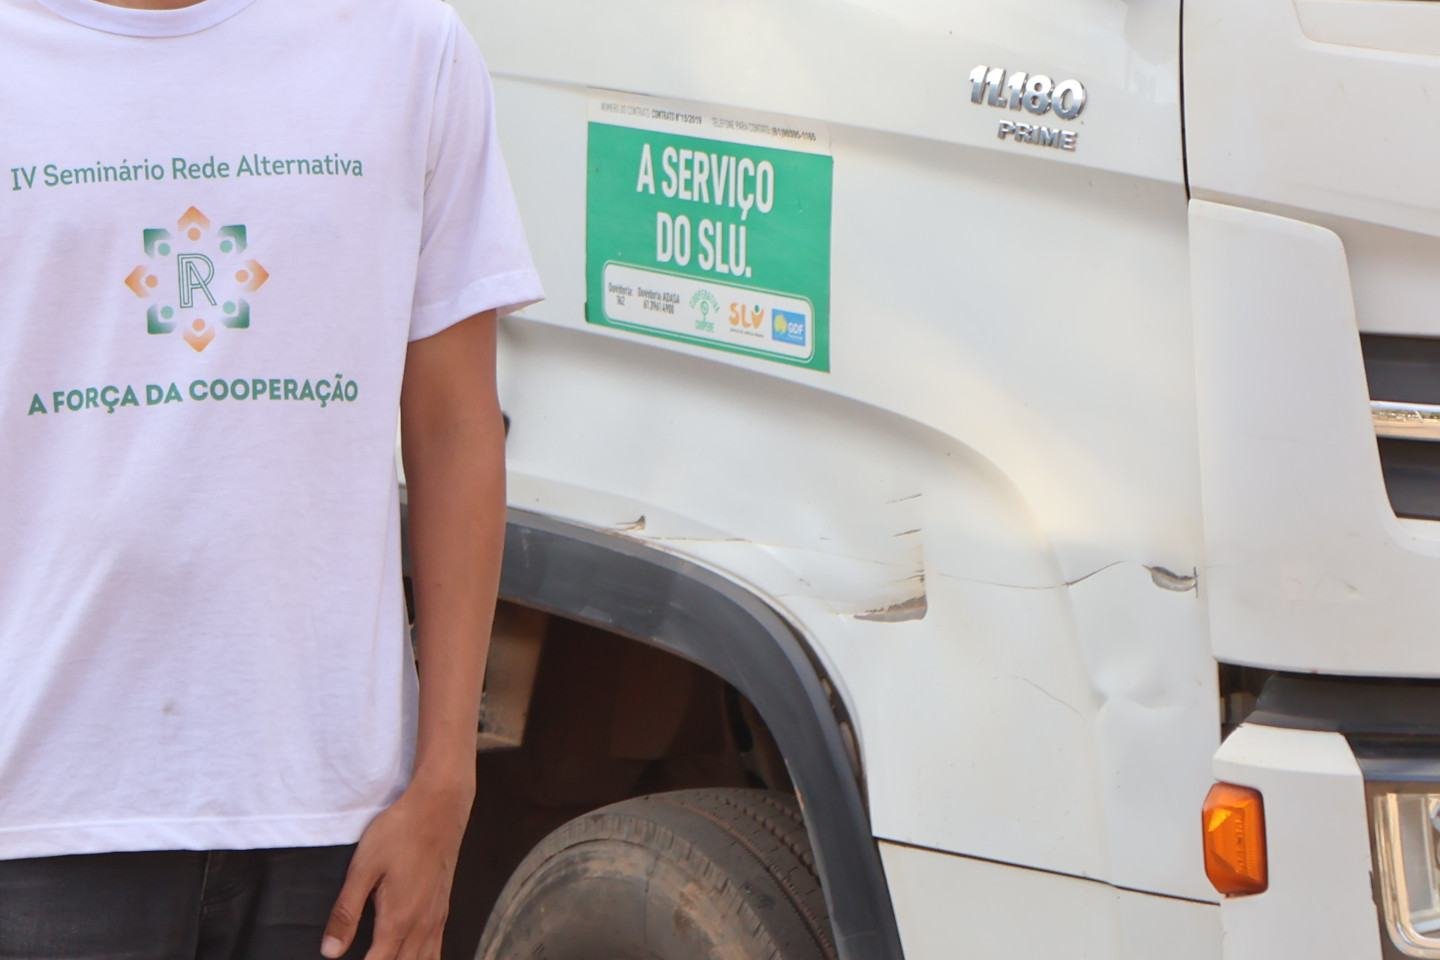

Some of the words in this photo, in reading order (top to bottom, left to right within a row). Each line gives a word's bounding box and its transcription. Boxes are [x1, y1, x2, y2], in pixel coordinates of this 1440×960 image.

[997, 119, 1078, 152] PRIME
[11, 166, 36, 191] IV
[44, 159, 164, 187] Seminário
[172, 156, 230, 180] Rede
[236, 154, 363, 177] Alternativa
[636, 143, 656, 195] A
[661, 146, 775, 221] SERVIÇO
[656, 212, 691, 267] DO
[27, 393, 47, 416] A
[53, 384, 139, 414] FORÇA
[146, 382, 183, 406] DA
[189, 373, 358, 408] COOPERAÇÃO
